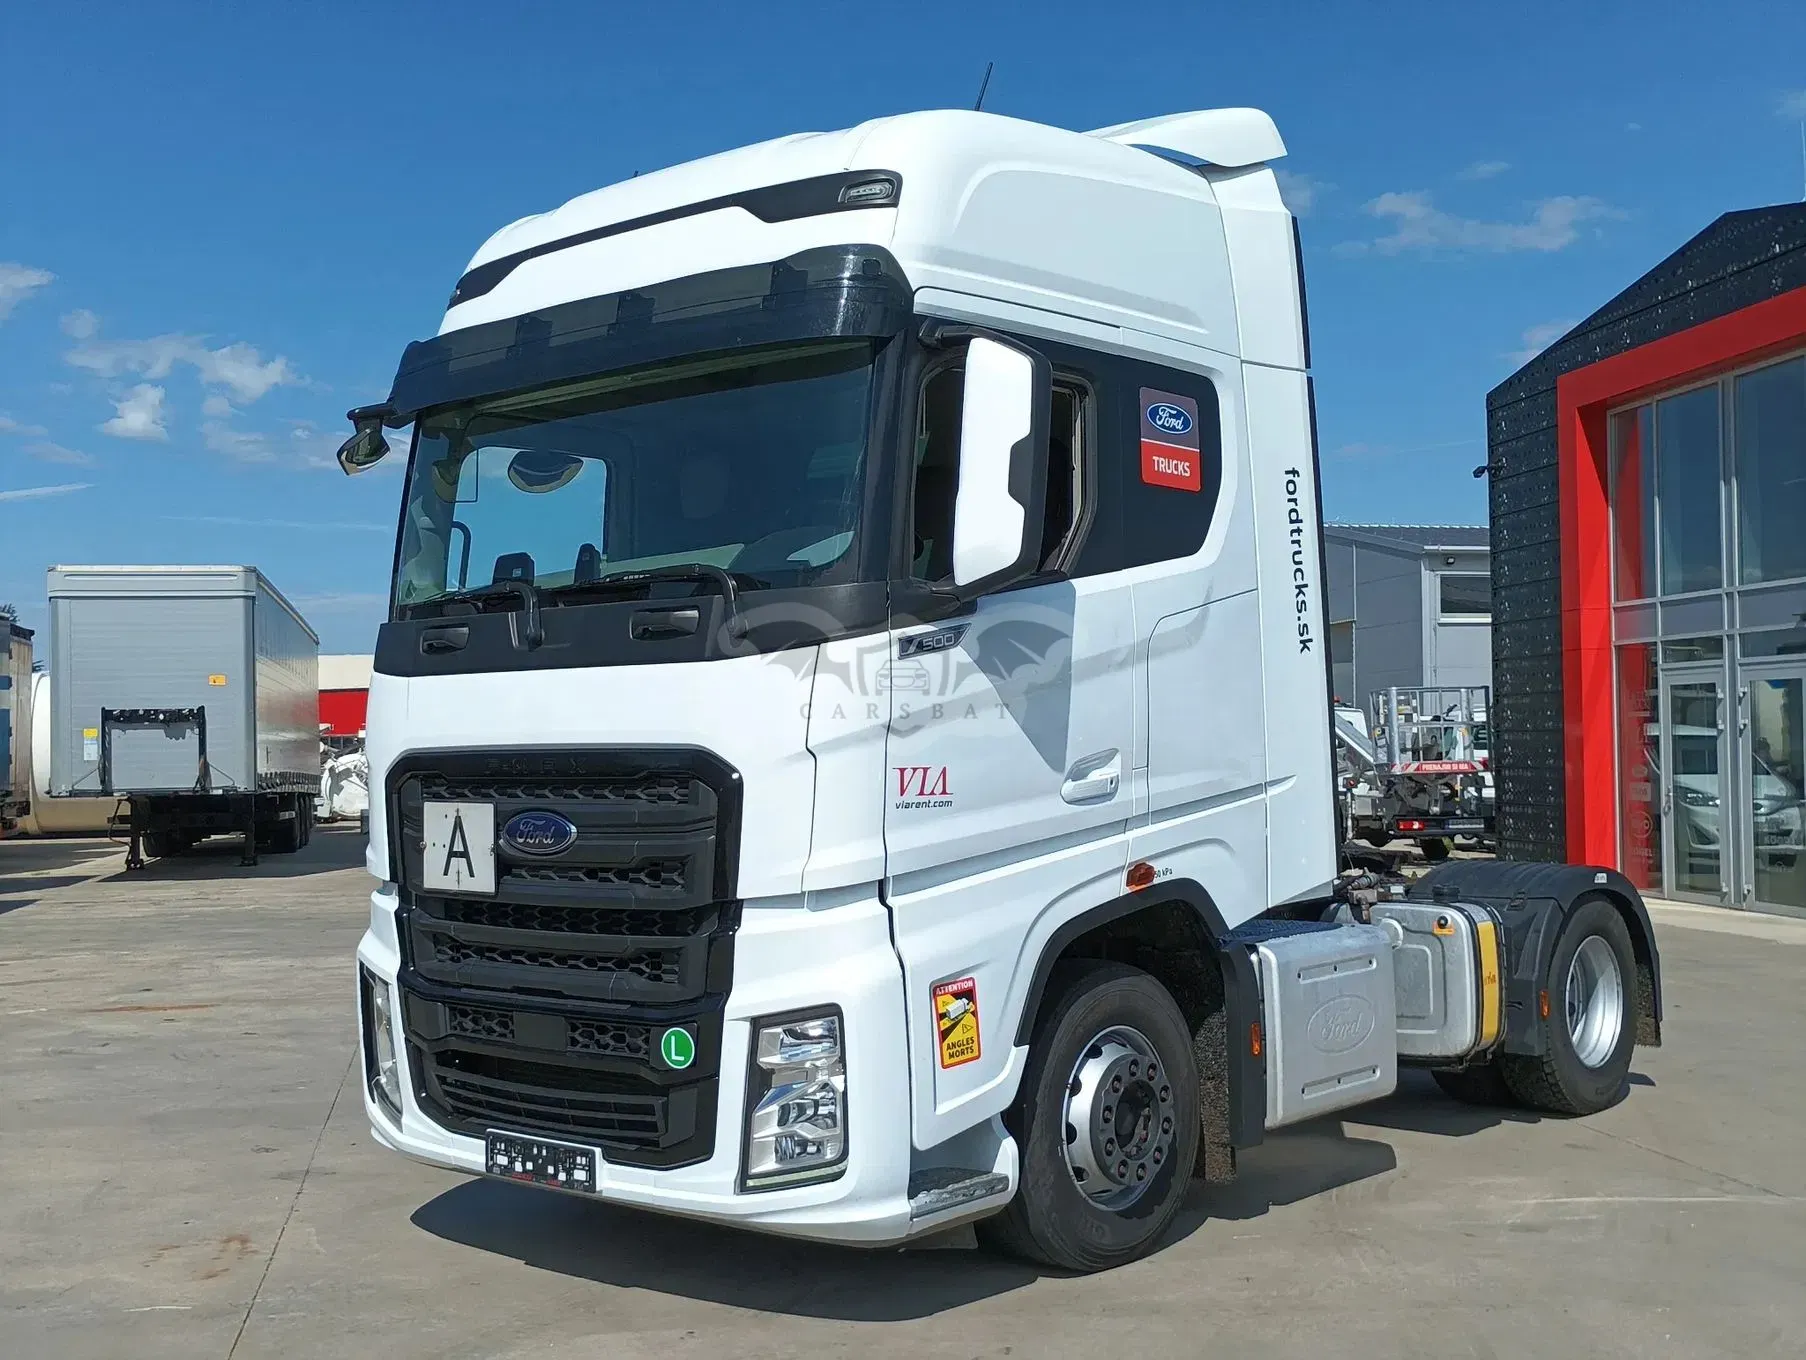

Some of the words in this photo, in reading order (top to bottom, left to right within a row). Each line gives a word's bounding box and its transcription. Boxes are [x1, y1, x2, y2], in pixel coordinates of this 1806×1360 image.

[1155, 406, 1184, 430] Ford
[1152, 456, 1191, 477] TRUCKS
[1284, 467, 1314, 655] fordtrucks.sk
[922, 633, 955, 651] 500
[892, 766, 954, 797] VIA
[895, 798, 953, 810] viarent.com
[515, 817, 556, 844] Ford
[442, 815, 476, 878] A
[936, 980, 974, 995] ATTENTION
[1321, 1006, 1364, 1041] Ford
[670, 1035, 685, 1061] L
[946, 1036, 975, 1052] ANGLES
[948, 1045, 975, 1060] MORTS
